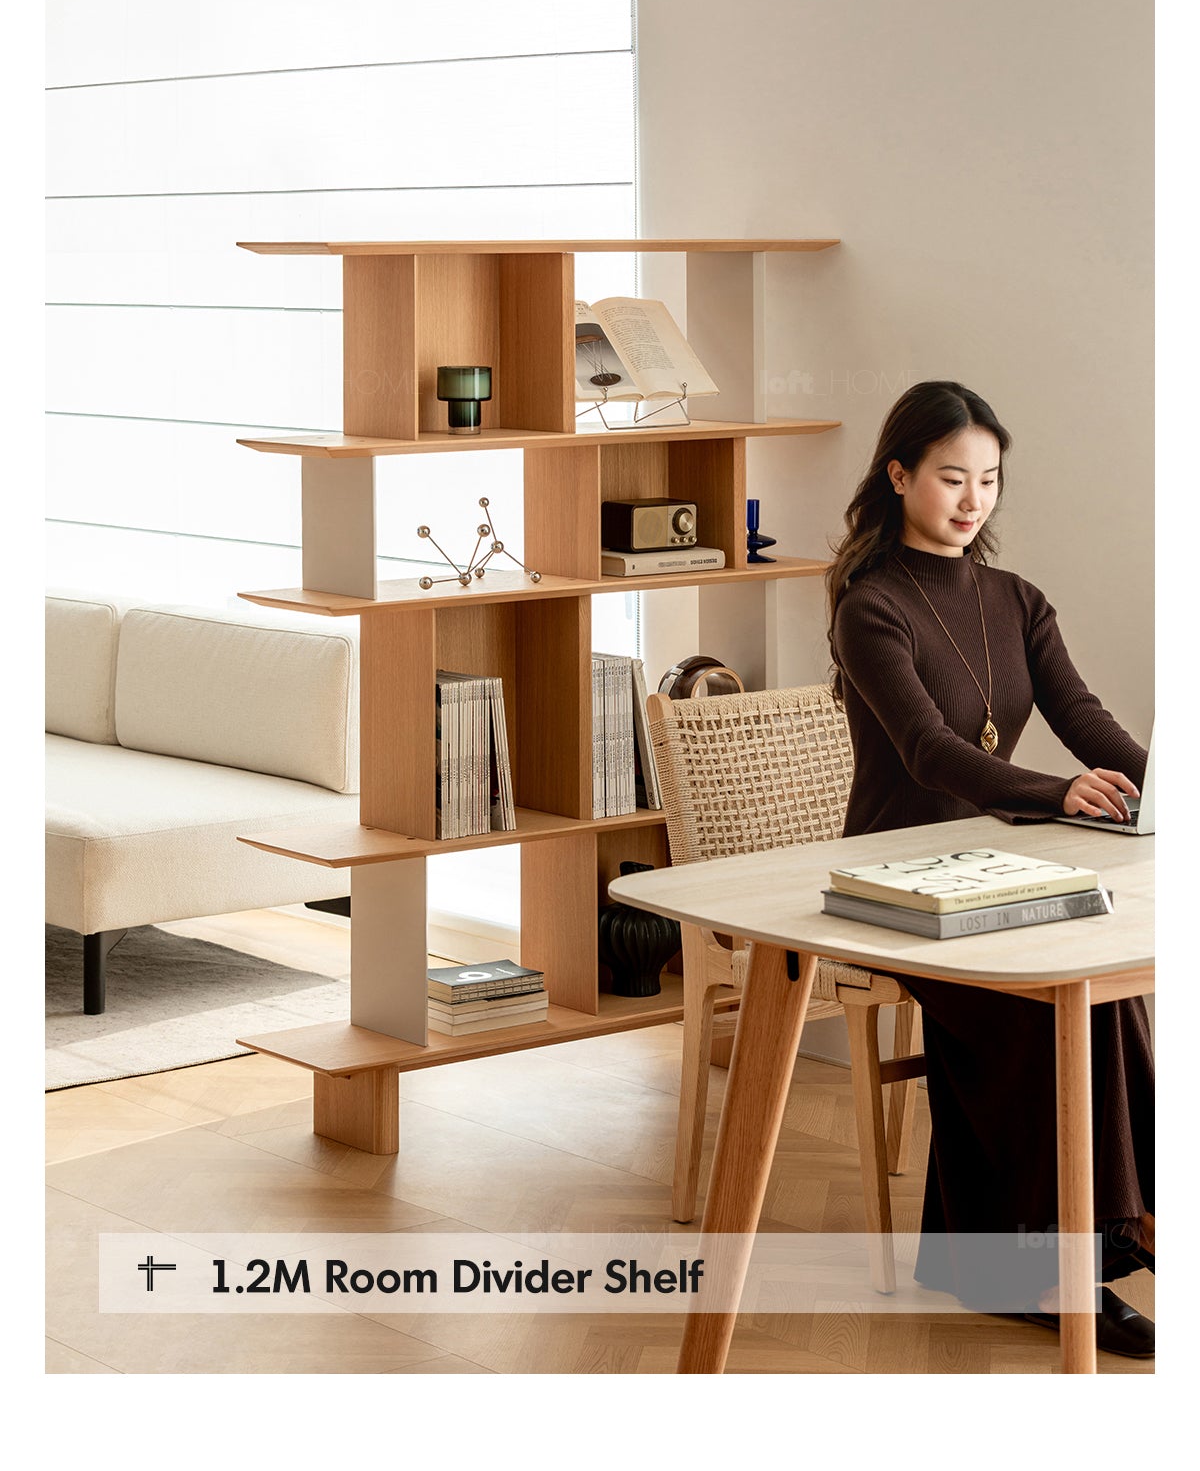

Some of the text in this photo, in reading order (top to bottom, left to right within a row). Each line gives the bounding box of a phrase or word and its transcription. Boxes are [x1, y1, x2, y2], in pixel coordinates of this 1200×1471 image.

[959, 902, 1065, 932] LOST IN NATURE
